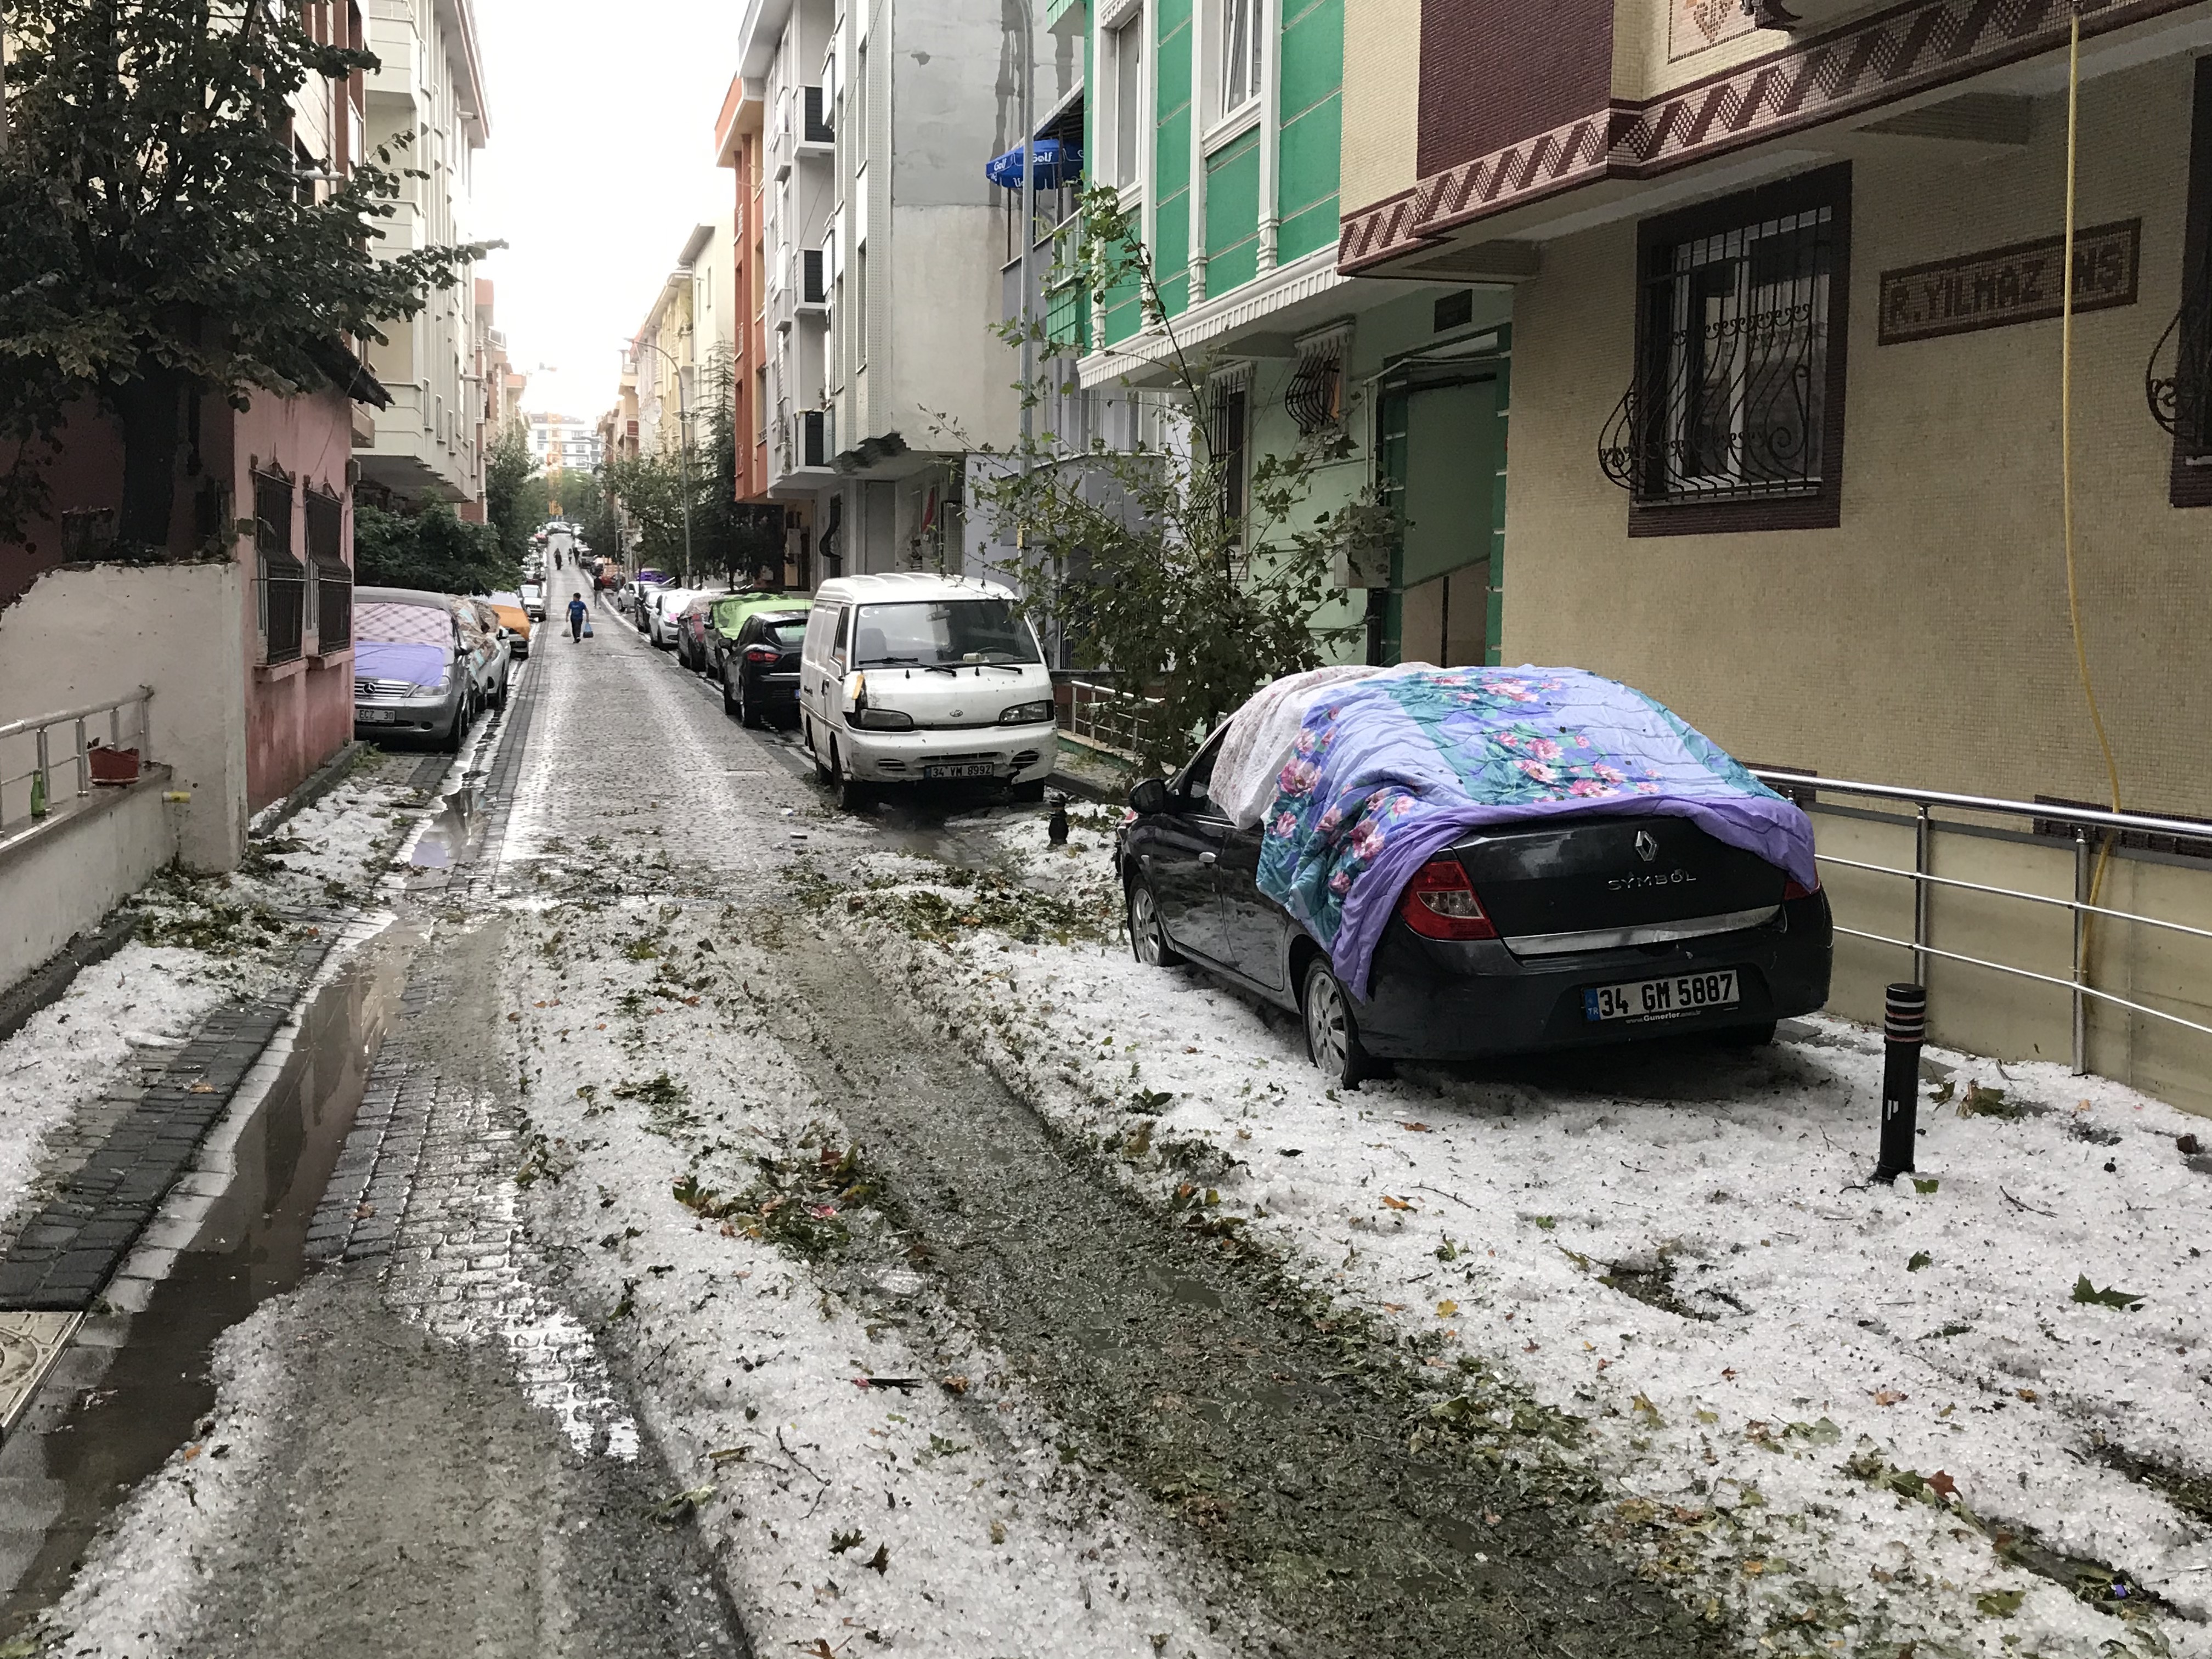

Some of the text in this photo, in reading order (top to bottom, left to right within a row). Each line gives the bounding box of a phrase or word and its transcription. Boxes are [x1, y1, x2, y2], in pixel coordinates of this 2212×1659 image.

[1032, 152, 1053, 163] Golf
[994, 158, 1007, 171] Golf
[359, 710, 374, 719] ECZ
[933, 768, 944, 777] 34
[967, 765, 991, 776] 8992
[1608, 870, 1697, 890] SYMBOL
[1599, 988, 1629, 1017] 34
[1641, 981, 1671, 1011] GM
[1677, 973, 1733, 1006] 5887
